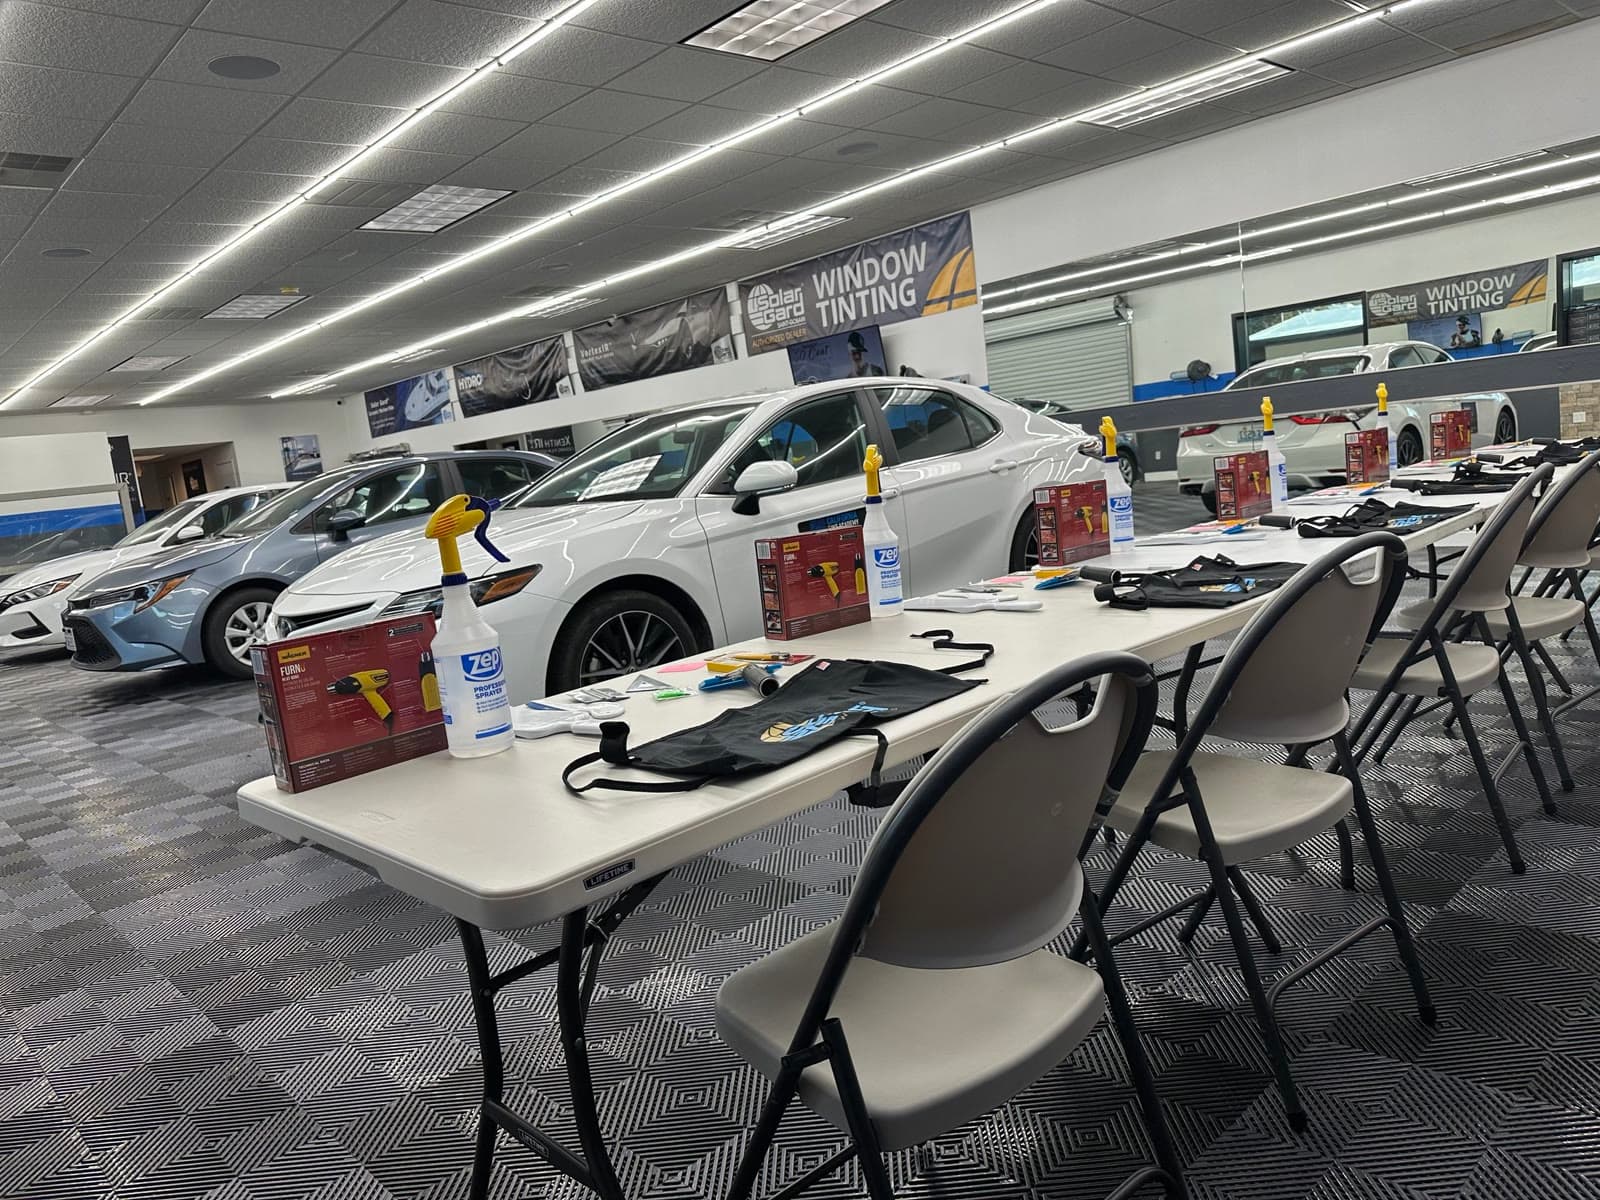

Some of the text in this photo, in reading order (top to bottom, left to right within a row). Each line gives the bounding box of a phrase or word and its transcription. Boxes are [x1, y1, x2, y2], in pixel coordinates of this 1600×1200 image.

[812, 241, 927, 300] WINDOW
[757, 287, 803, 311] Solar
[1425, 272, 1516, 301] WINDOW
[763, 292, 805, 324] Gard
[815, 277, 917, 328] TINTING
[1426, 290, 1505, 315] TINTING
[590, 863, 630, 886] LIFETIME
